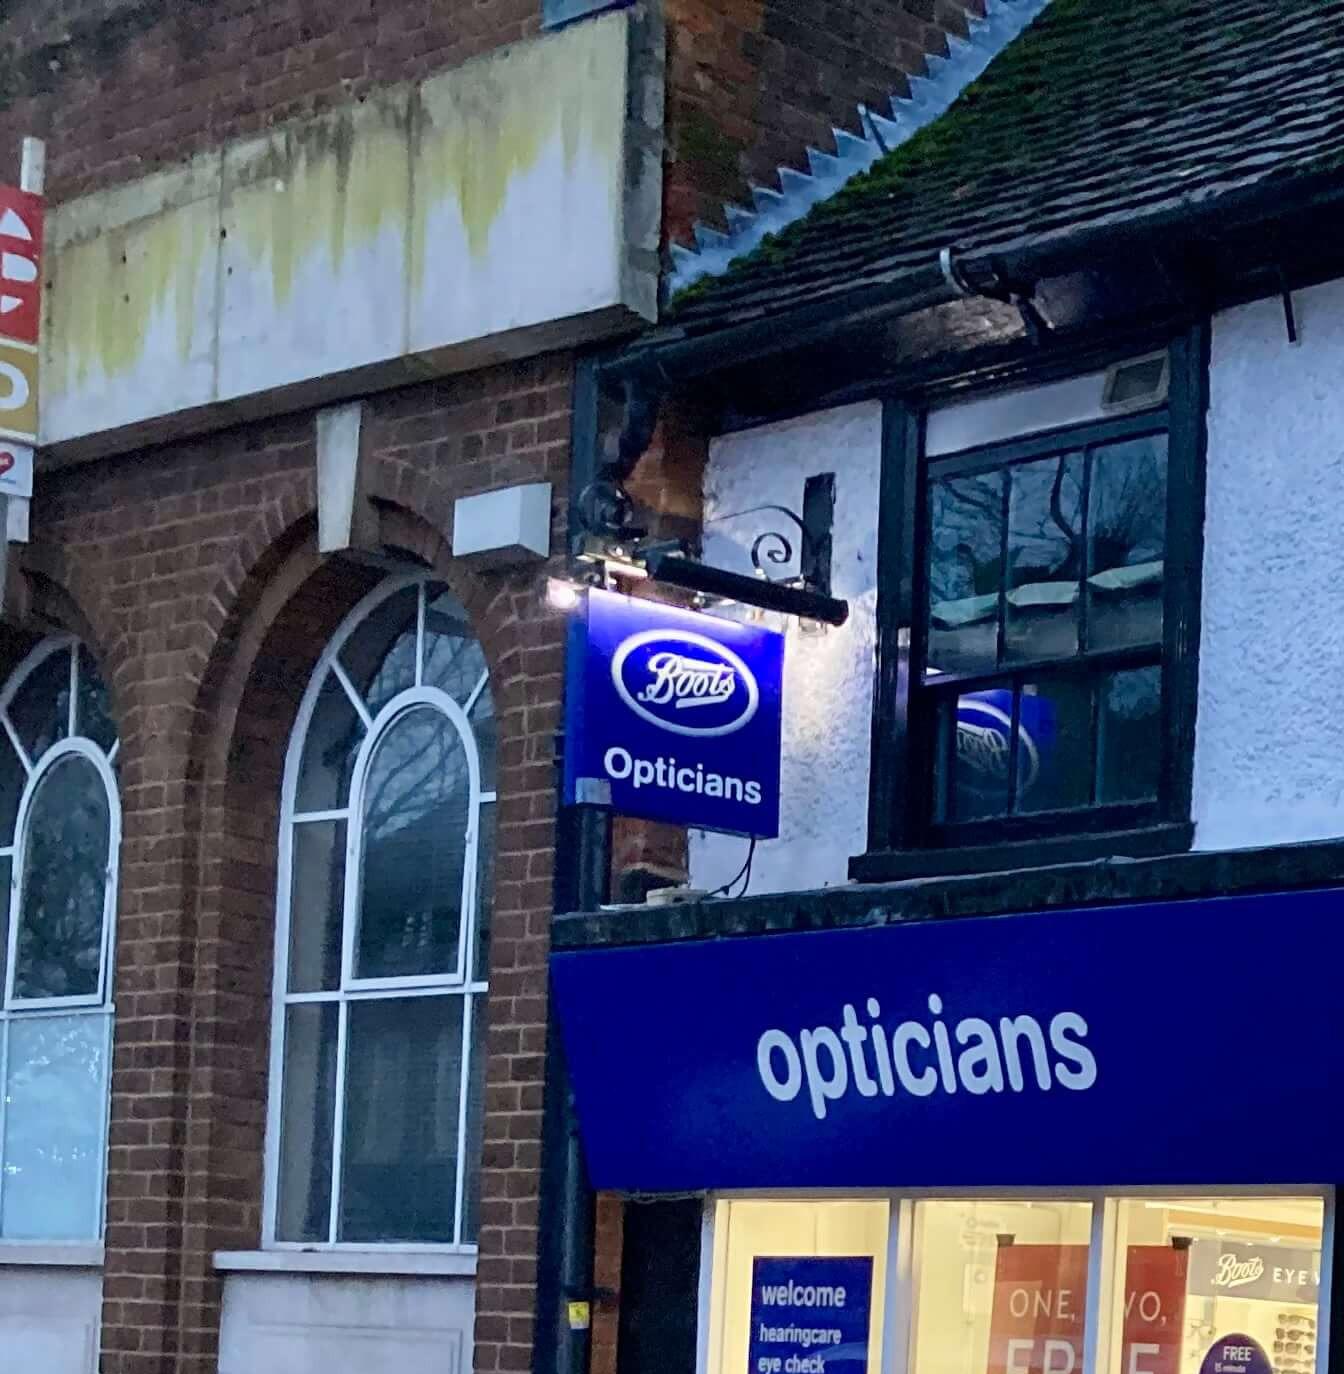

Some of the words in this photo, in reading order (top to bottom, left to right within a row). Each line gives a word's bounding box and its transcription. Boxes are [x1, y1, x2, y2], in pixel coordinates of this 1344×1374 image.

[637, 652, 736, 710] Boots
[604, 747, 762, 804] Opticians
[756, 993, 1097, 1120] opticians
[1211, 1253, 1264, 1288] Boots
[762, 1279, 846, 1307] welcome
[1009, 1288, 1075, 1321] ONE,
[759, 1323, 842, 1347] hearingcare
[785, 1353, 825, 1374] check
[1223, 1346, 1251, 1362] FREE
